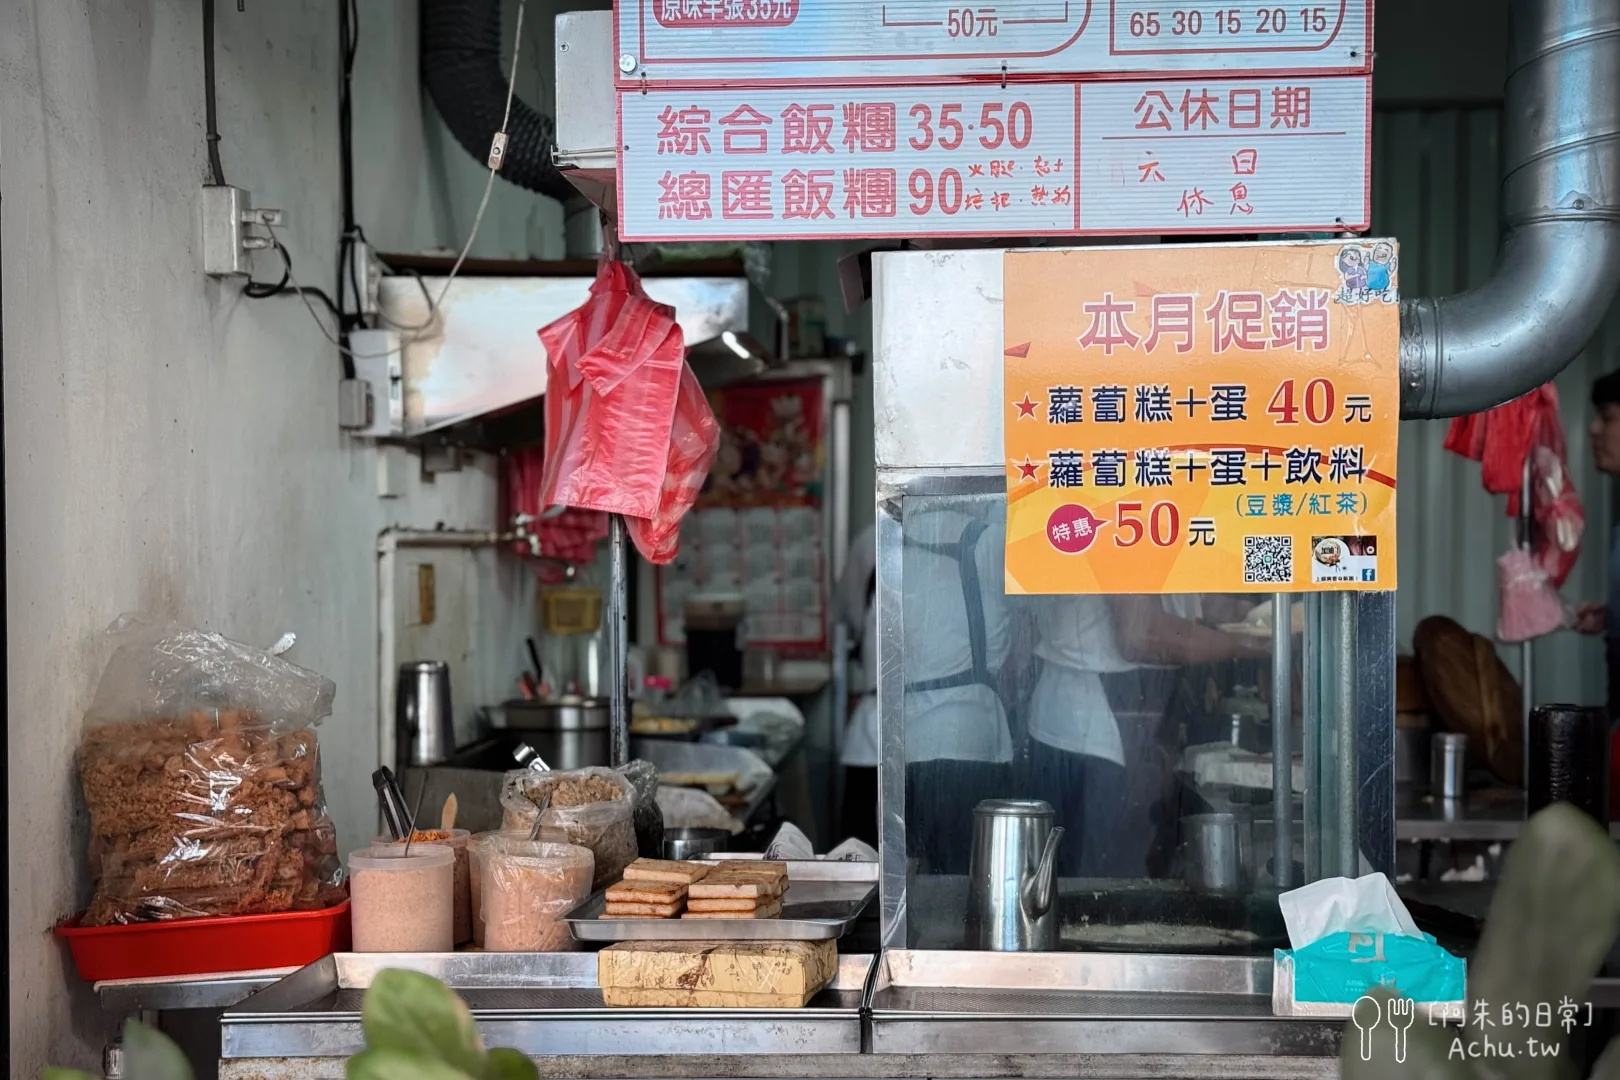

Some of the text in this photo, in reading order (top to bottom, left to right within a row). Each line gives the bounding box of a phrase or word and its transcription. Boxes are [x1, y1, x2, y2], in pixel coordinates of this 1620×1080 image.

[948, 9, 998, 37] 50元
[1129, 8, 1327, 37] 65 30 15 20 15
[1134, 86, 1311, 131] 公休日期
[1232, 148, 1258, 175] 日
[1177, 181, 1254, 217] 休息
[1079, 290, 1331, 355] 本月促銷
[1052, 516, 1093, 543] 特惠
